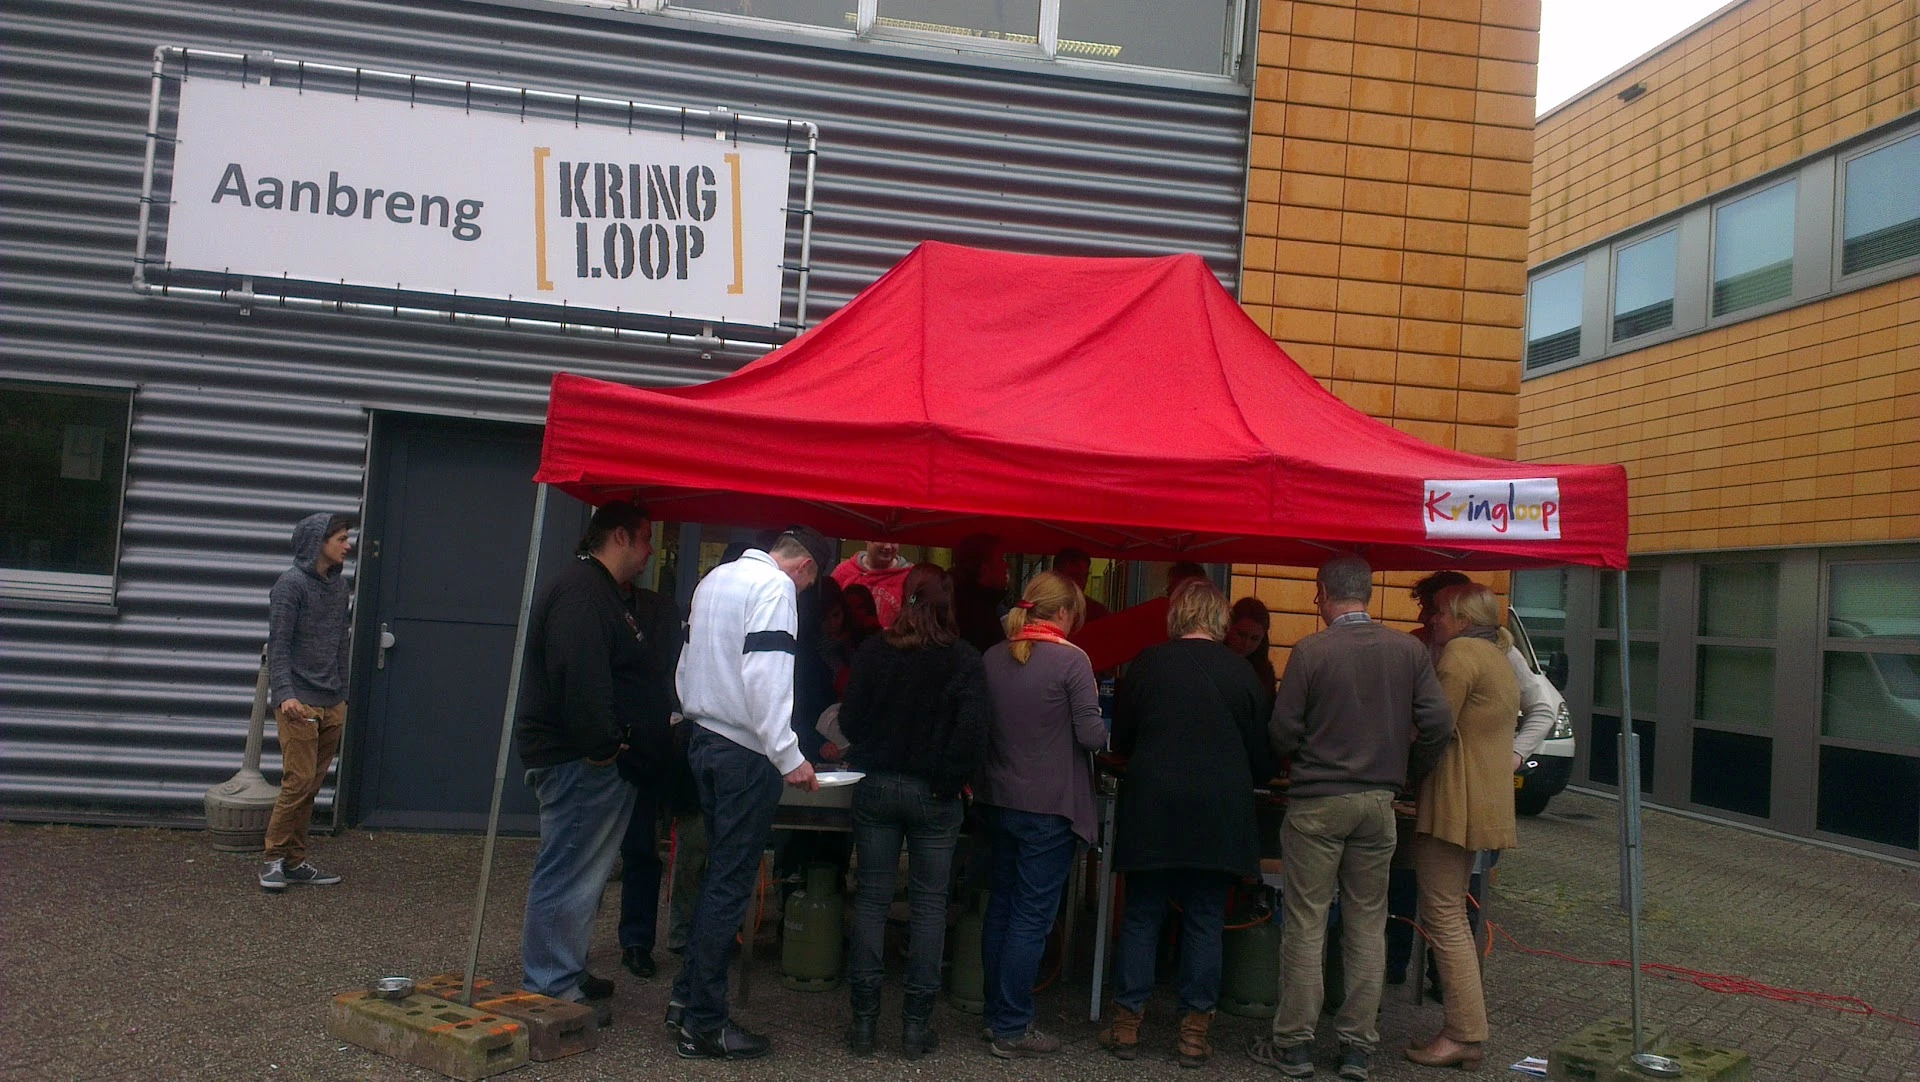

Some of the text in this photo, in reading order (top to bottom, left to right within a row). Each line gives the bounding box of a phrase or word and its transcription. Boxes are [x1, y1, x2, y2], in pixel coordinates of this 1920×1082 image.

[212, 163, 484, 241] Aanbreng
[559, 161, 717, 222] KRING
[576, 221, 705, 280] LOOP
[1425, 482, 1557, 533] Kringloop
